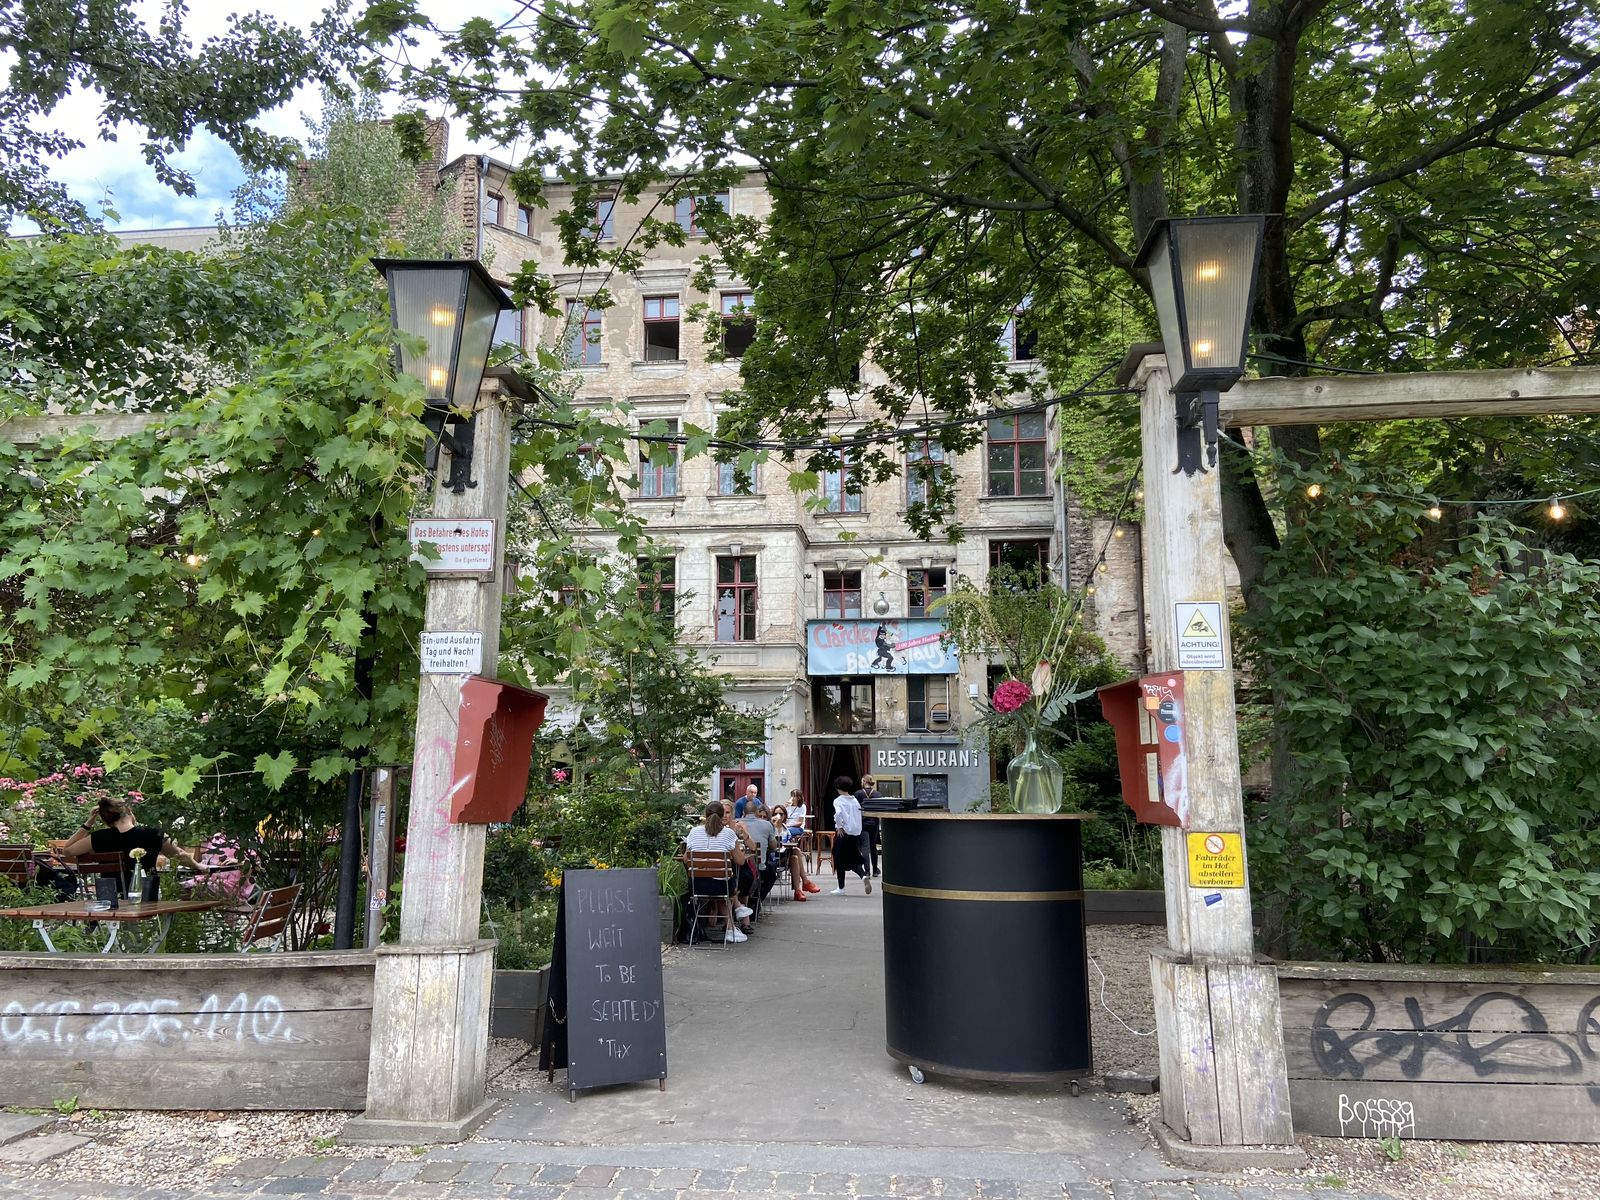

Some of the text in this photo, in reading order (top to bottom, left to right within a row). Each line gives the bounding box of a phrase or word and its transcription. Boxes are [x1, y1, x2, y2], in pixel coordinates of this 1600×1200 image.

[415, 528, 427, 538] Das
[471, 528, 489, 538] Hofes
[461, 544, 491, 555] untersagt
[449, 636, 481, 645] Ausfahrt
[426, 647, 474, 657] Tag und Nacht
[577, 887, 635, 914] PLEASE
[619, 965, 637, 984] BE
